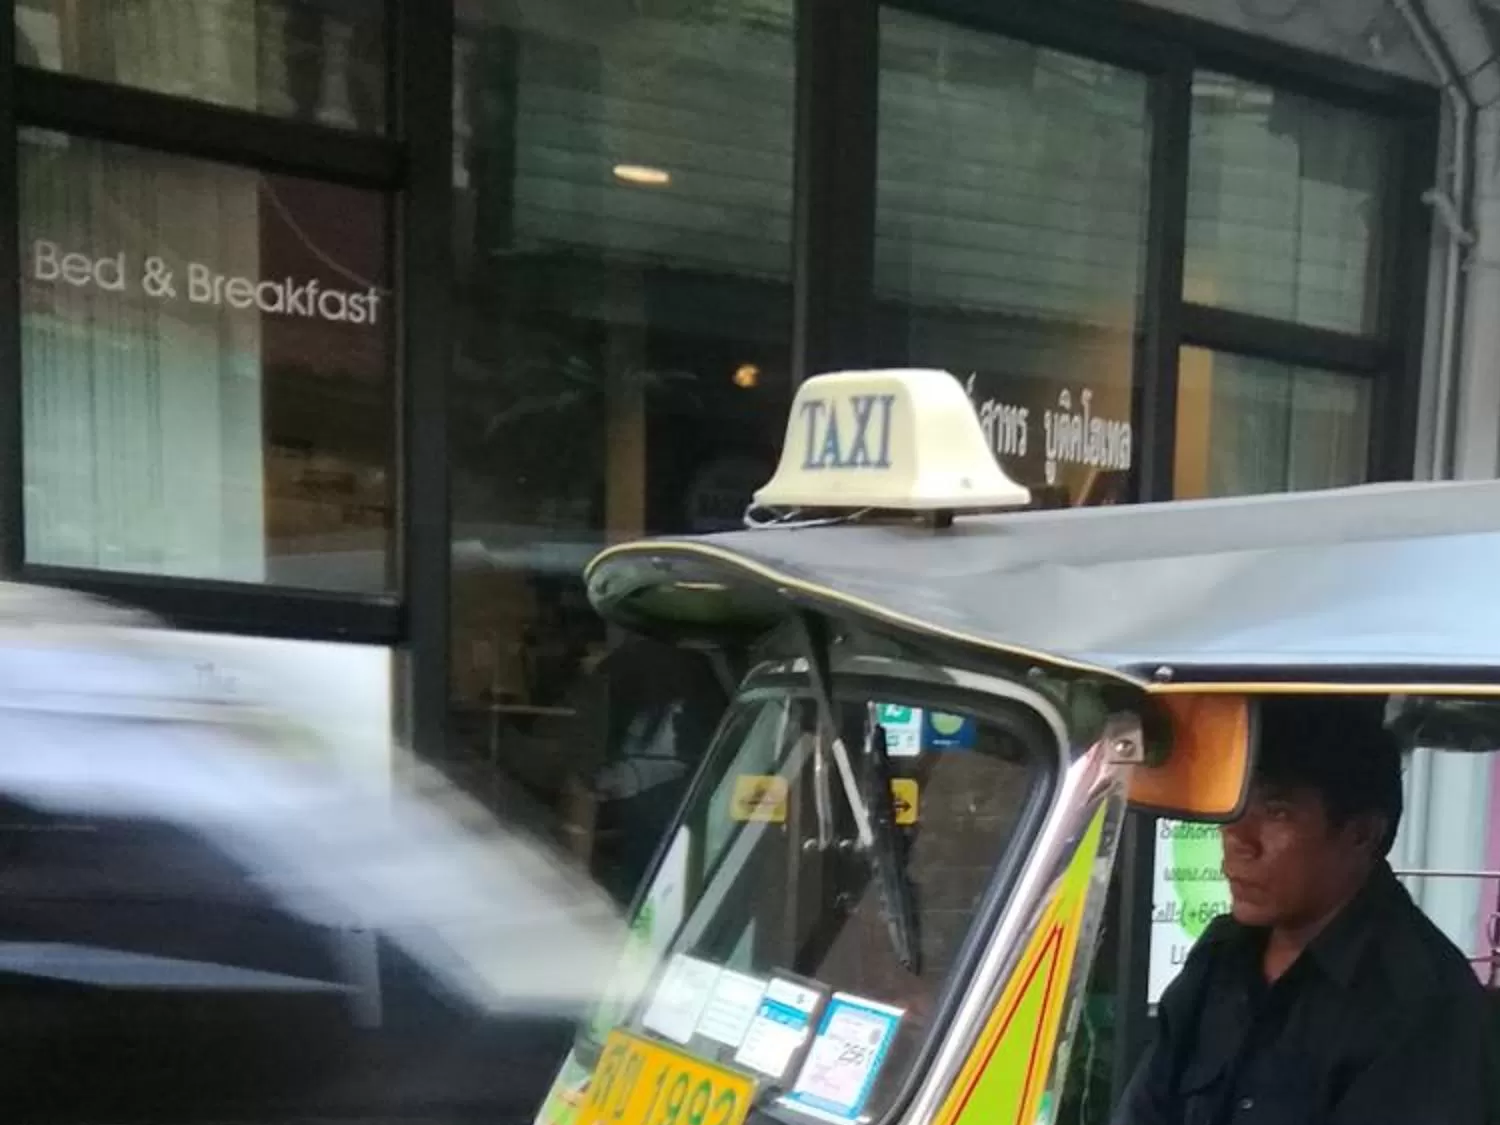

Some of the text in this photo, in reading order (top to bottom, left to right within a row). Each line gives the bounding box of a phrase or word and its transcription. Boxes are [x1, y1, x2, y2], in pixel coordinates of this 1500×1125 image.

[34, 239, 380, 325] Bed & Breakfast
[801, 395, 895, 469] TAXI
